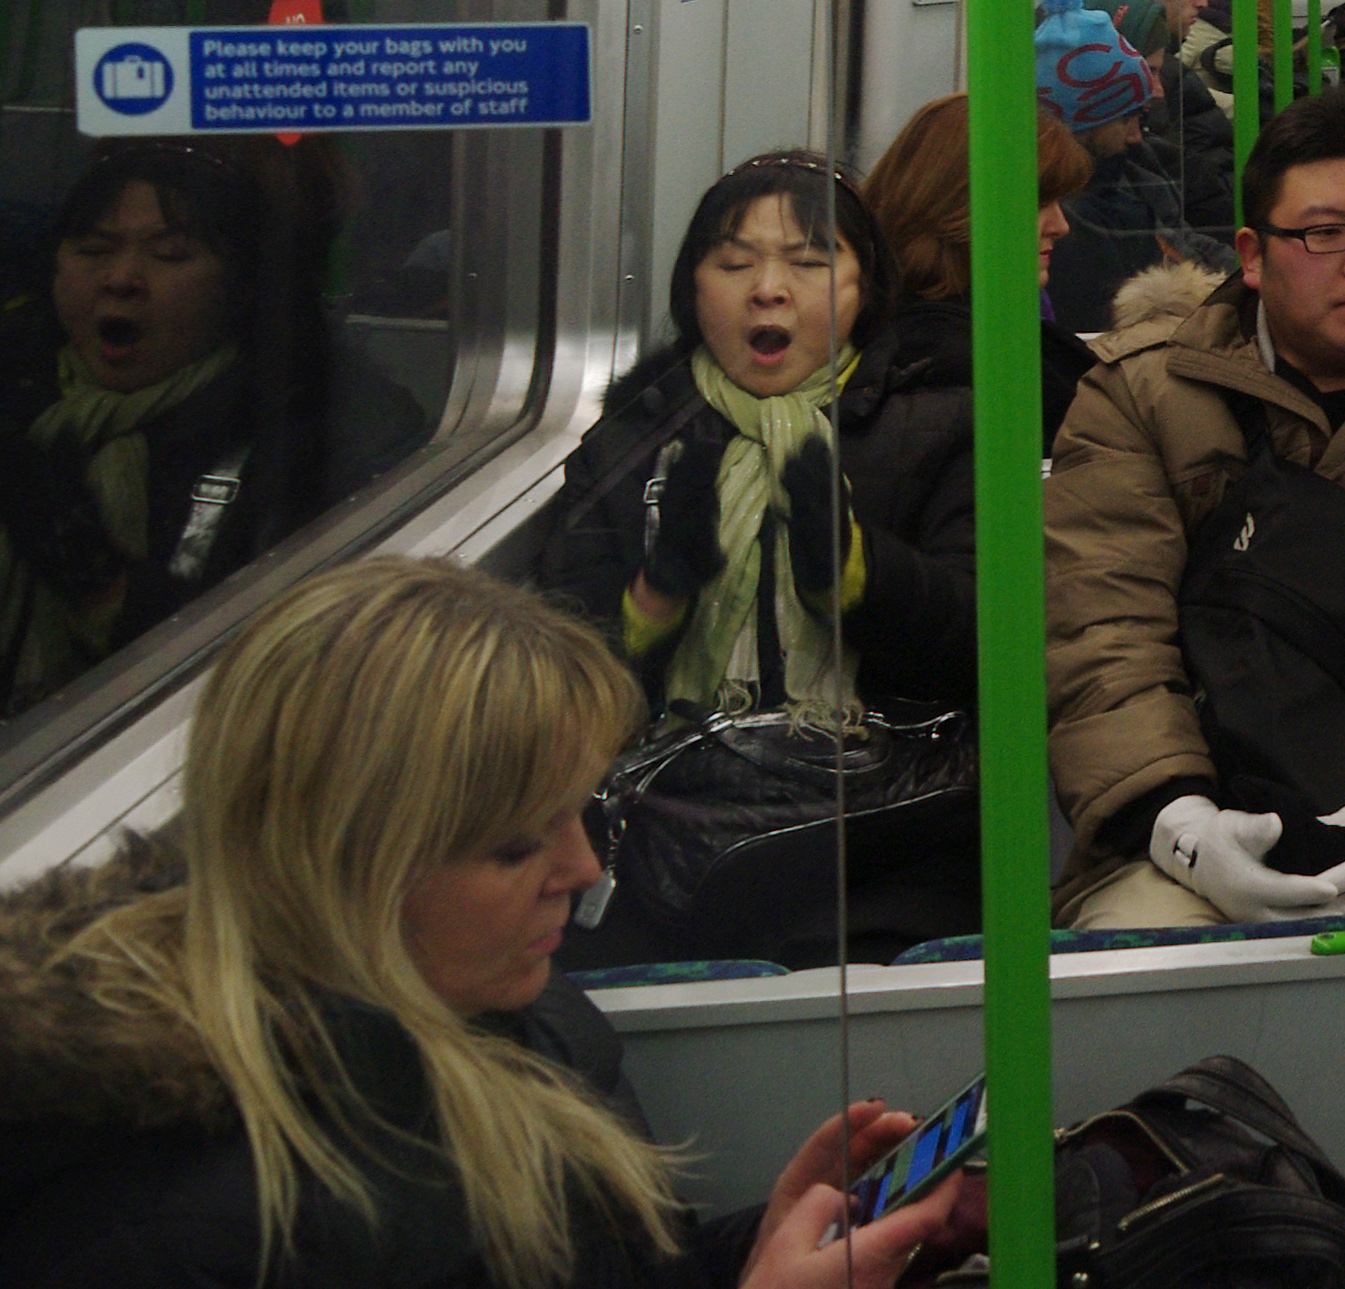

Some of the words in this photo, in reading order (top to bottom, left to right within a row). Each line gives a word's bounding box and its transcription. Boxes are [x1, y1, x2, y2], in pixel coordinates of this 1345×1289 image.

[204, 39, 271, 57] Please
[277, 38, 327, 60] keep
[334, 40, 378, 58] your
[385, 37, 432, 58] bags
[439, 36, 483, 54] with
[489, 38, 527, 57] you
[205, 61, 226, 78] at
[232, 60, 258, 77] all
[264, 60, 320, 77] times
[327, 59, 365, 77] and
[371, 59, 437, 79] report
[443, 59, 479, 78] any
[205, 81, 327, 100] unattended
[334, 80, 390, 97] items
[398, 82, 417, 96] or
[424, 79, 528, 98] suspicious
[205, 103, 306, 121] behaviour
[314, 103, 336, 117] to
[343, 105, 354, 117] a
[360, 100, 444, 117] member
[450, 99, 472, 116] of
[479, 98, 528, 115] staff
